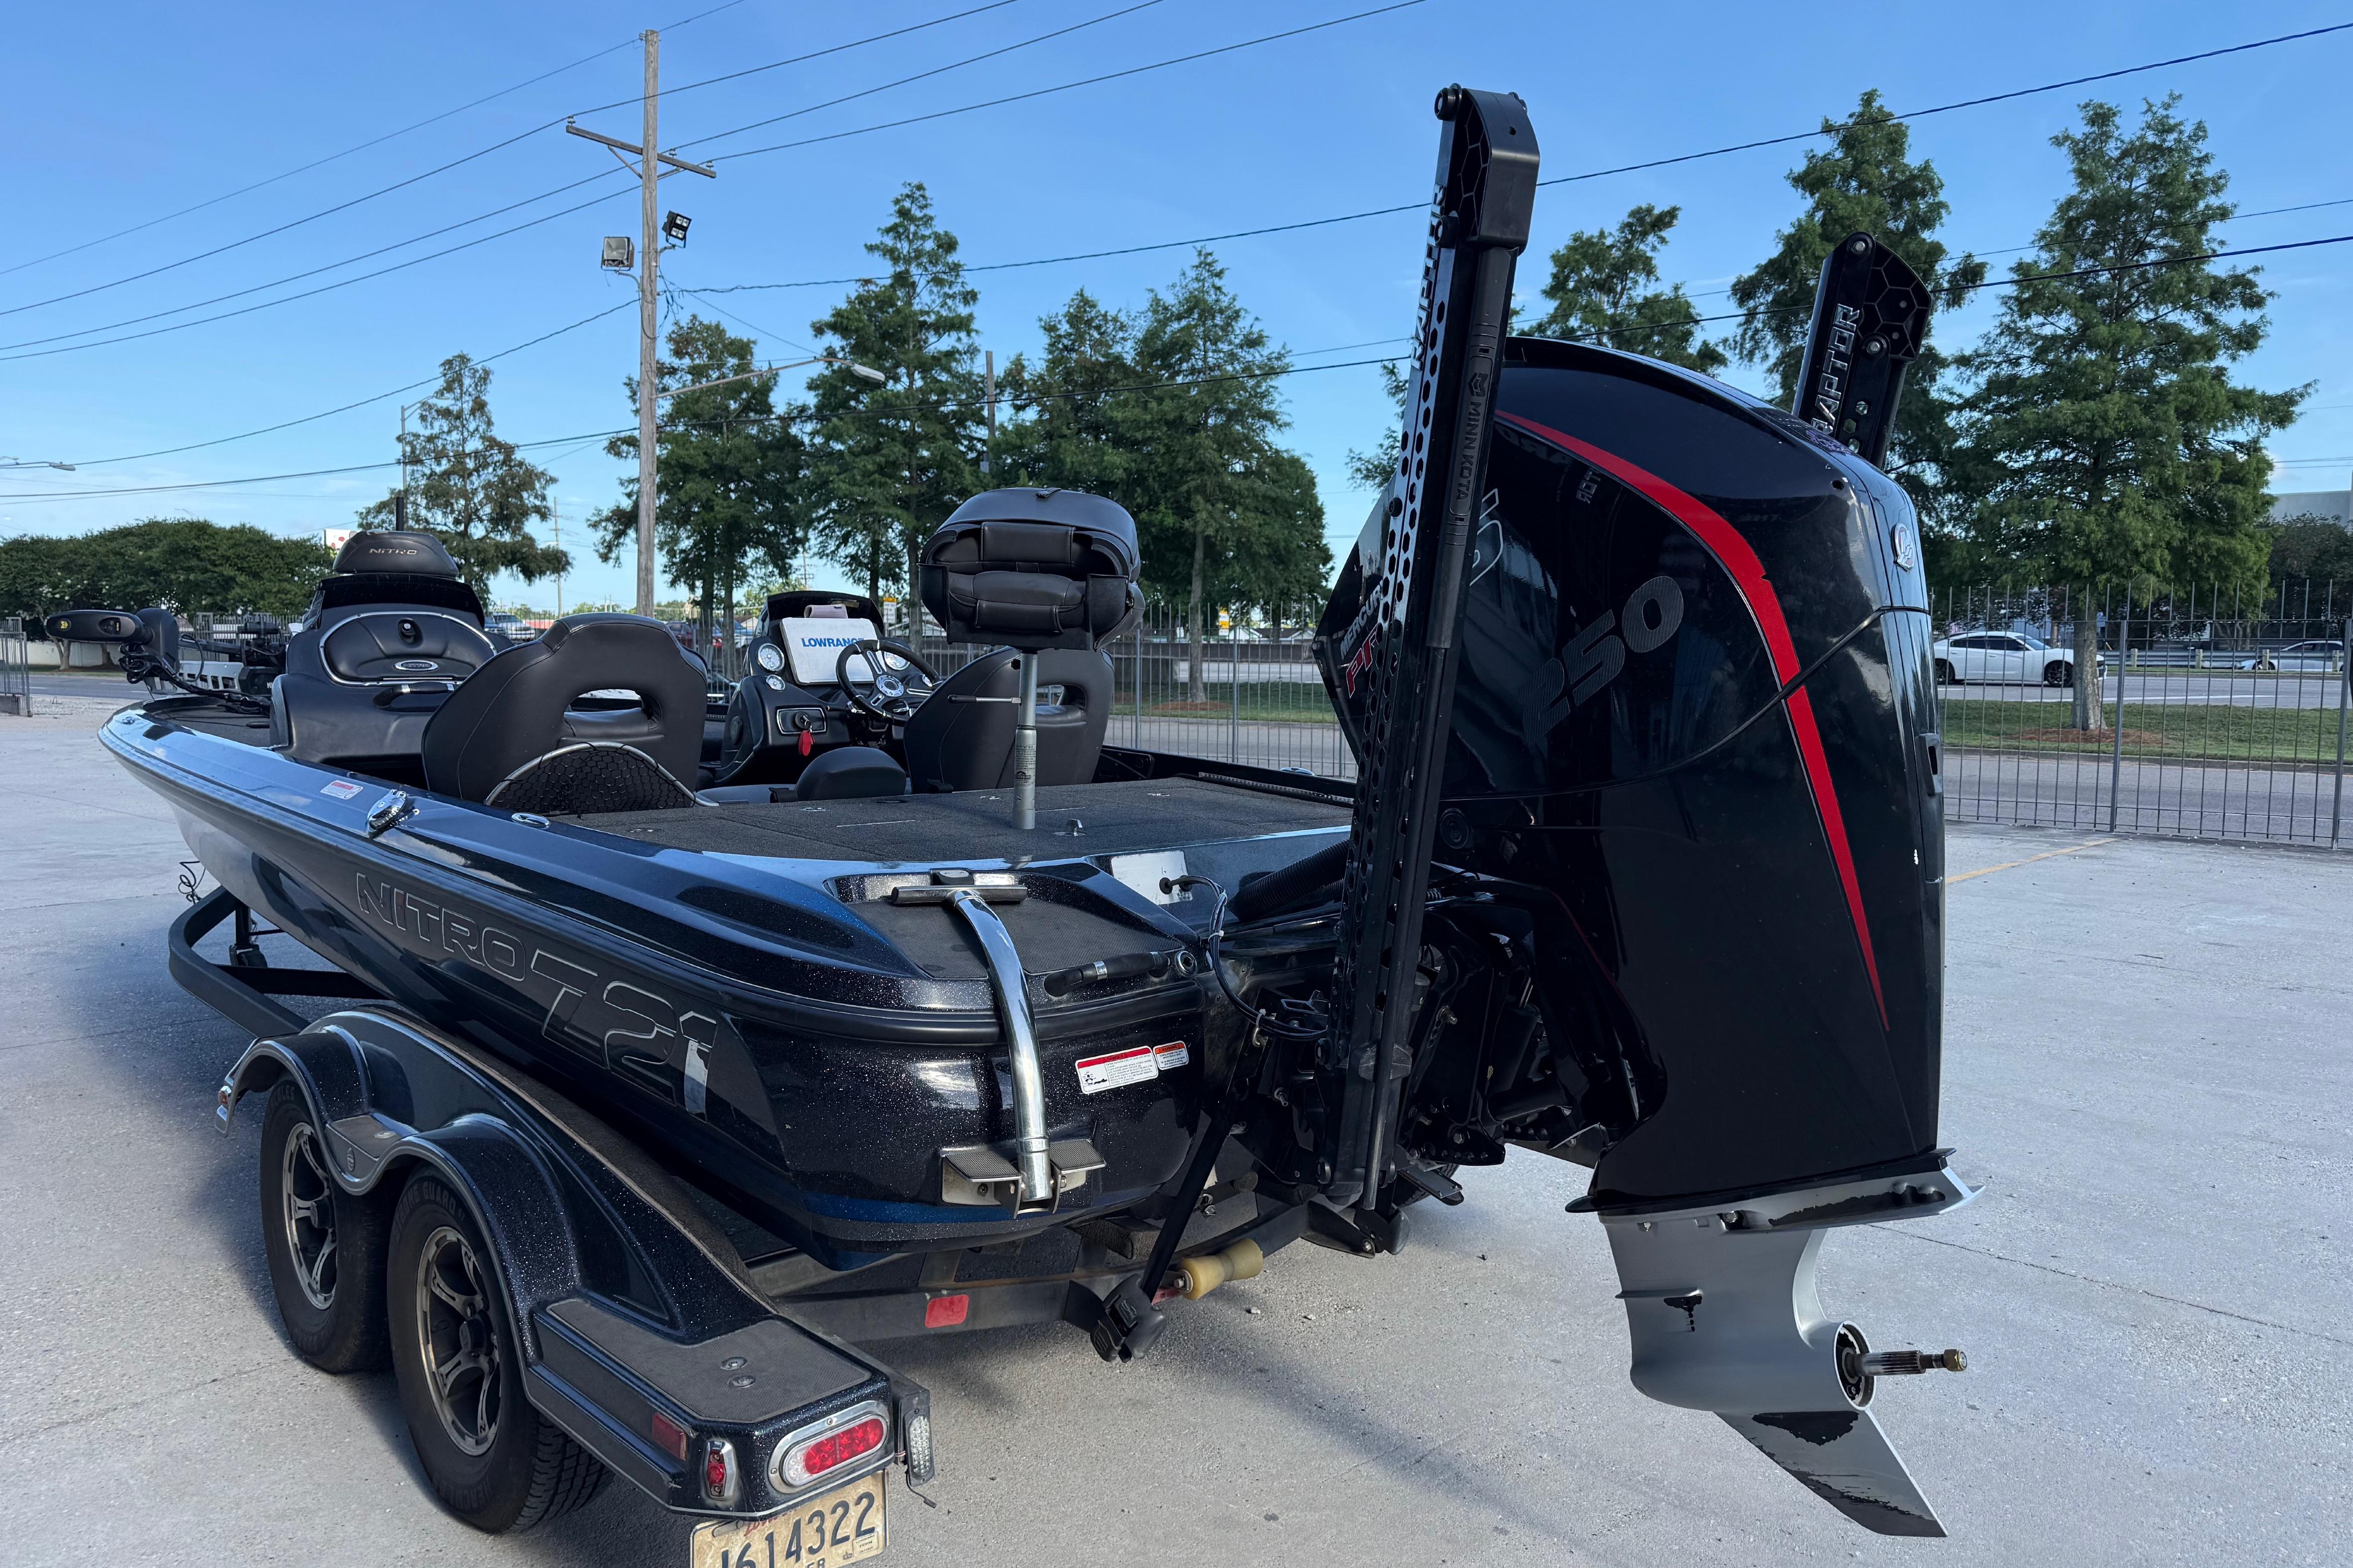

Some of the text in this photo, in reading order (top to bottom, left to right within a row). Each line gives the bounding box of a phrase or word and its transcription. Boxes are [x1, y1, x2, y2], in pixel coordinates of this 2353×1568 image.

[1456, 401, 1482, 501] MINN KOTA
[801, 637, 864, 647] LOWRAN
[1340, 579, 1383, 661] MERCUR
[1518, 576, 1684, 745] 250
[356, 872, 526, 982] NITRO
[422, 1181, 456, 1216] GUARD
